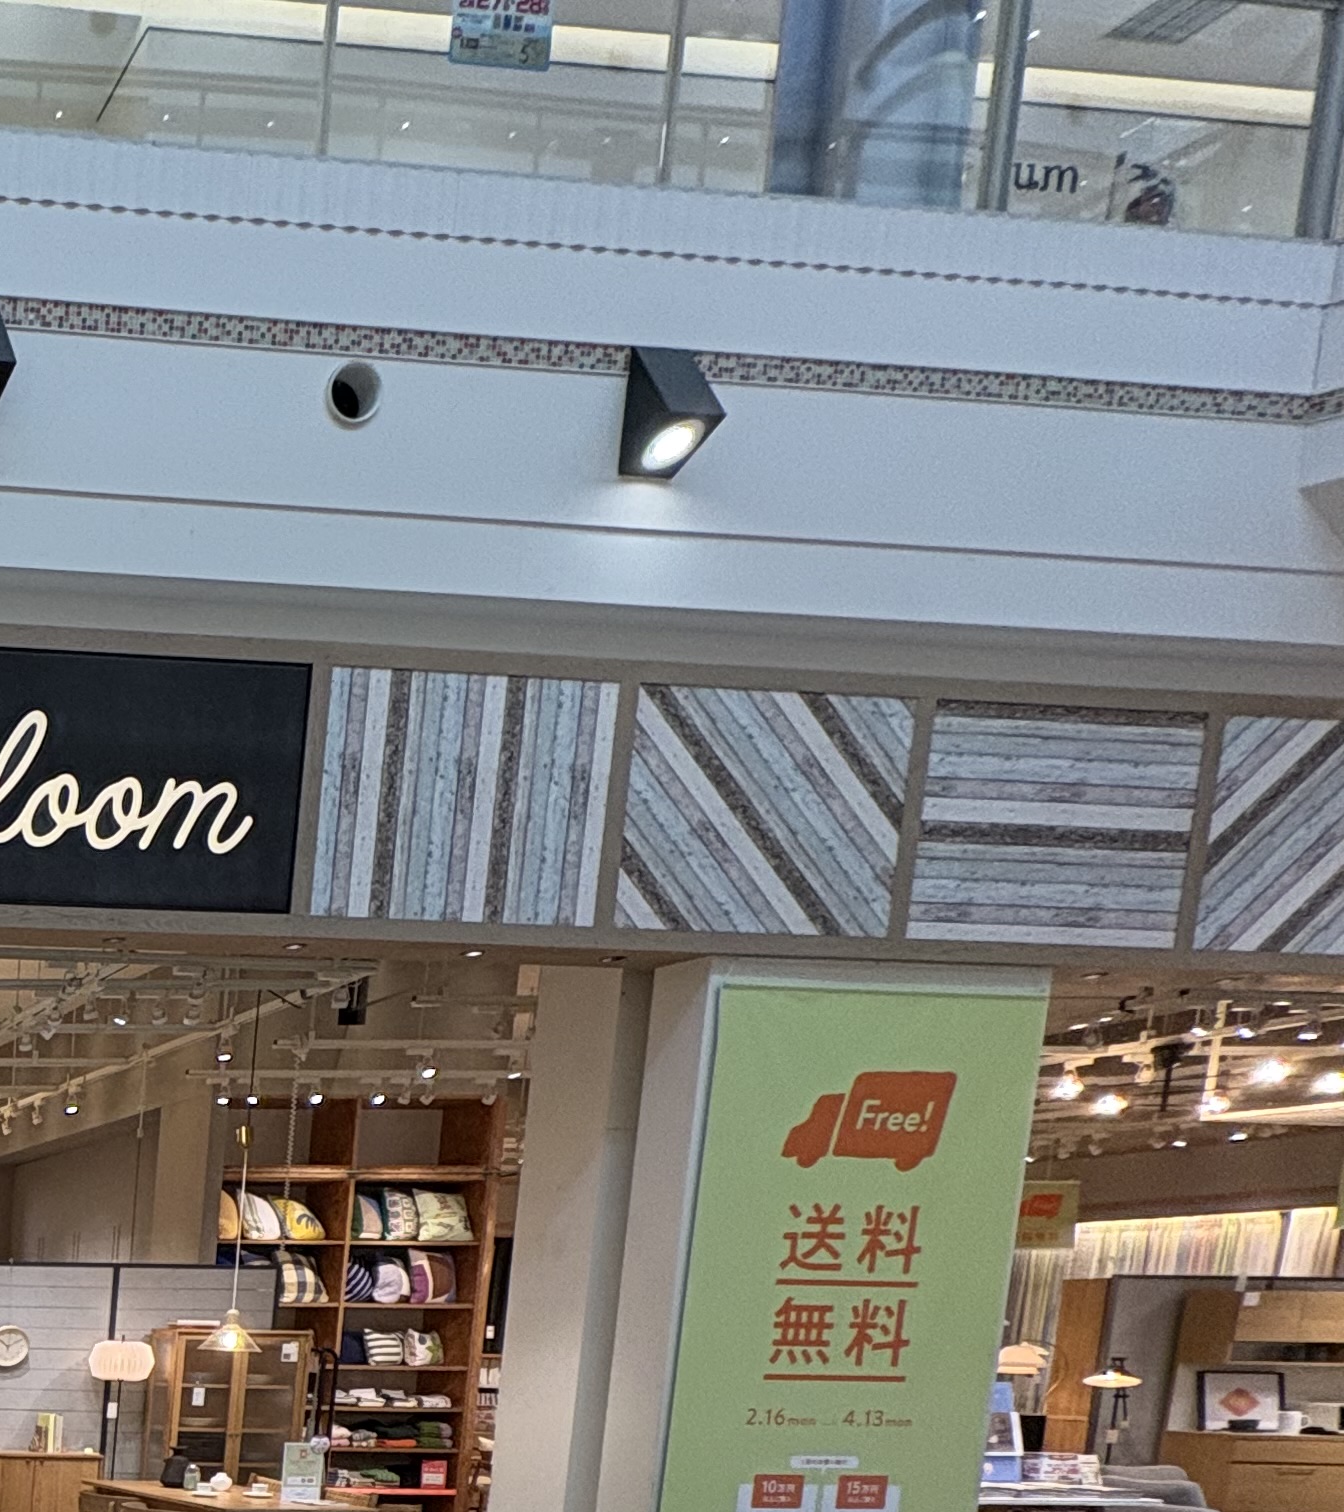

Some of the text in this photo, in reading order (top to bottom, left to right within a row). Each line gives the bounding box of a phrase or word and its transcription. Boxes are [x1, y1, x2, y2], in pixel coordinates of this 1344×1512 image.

[854, 1098, 935, 1134] Free!
[780, 1203, 921, 1275] 送料
[769, 1296, 910, 1368] 無料
